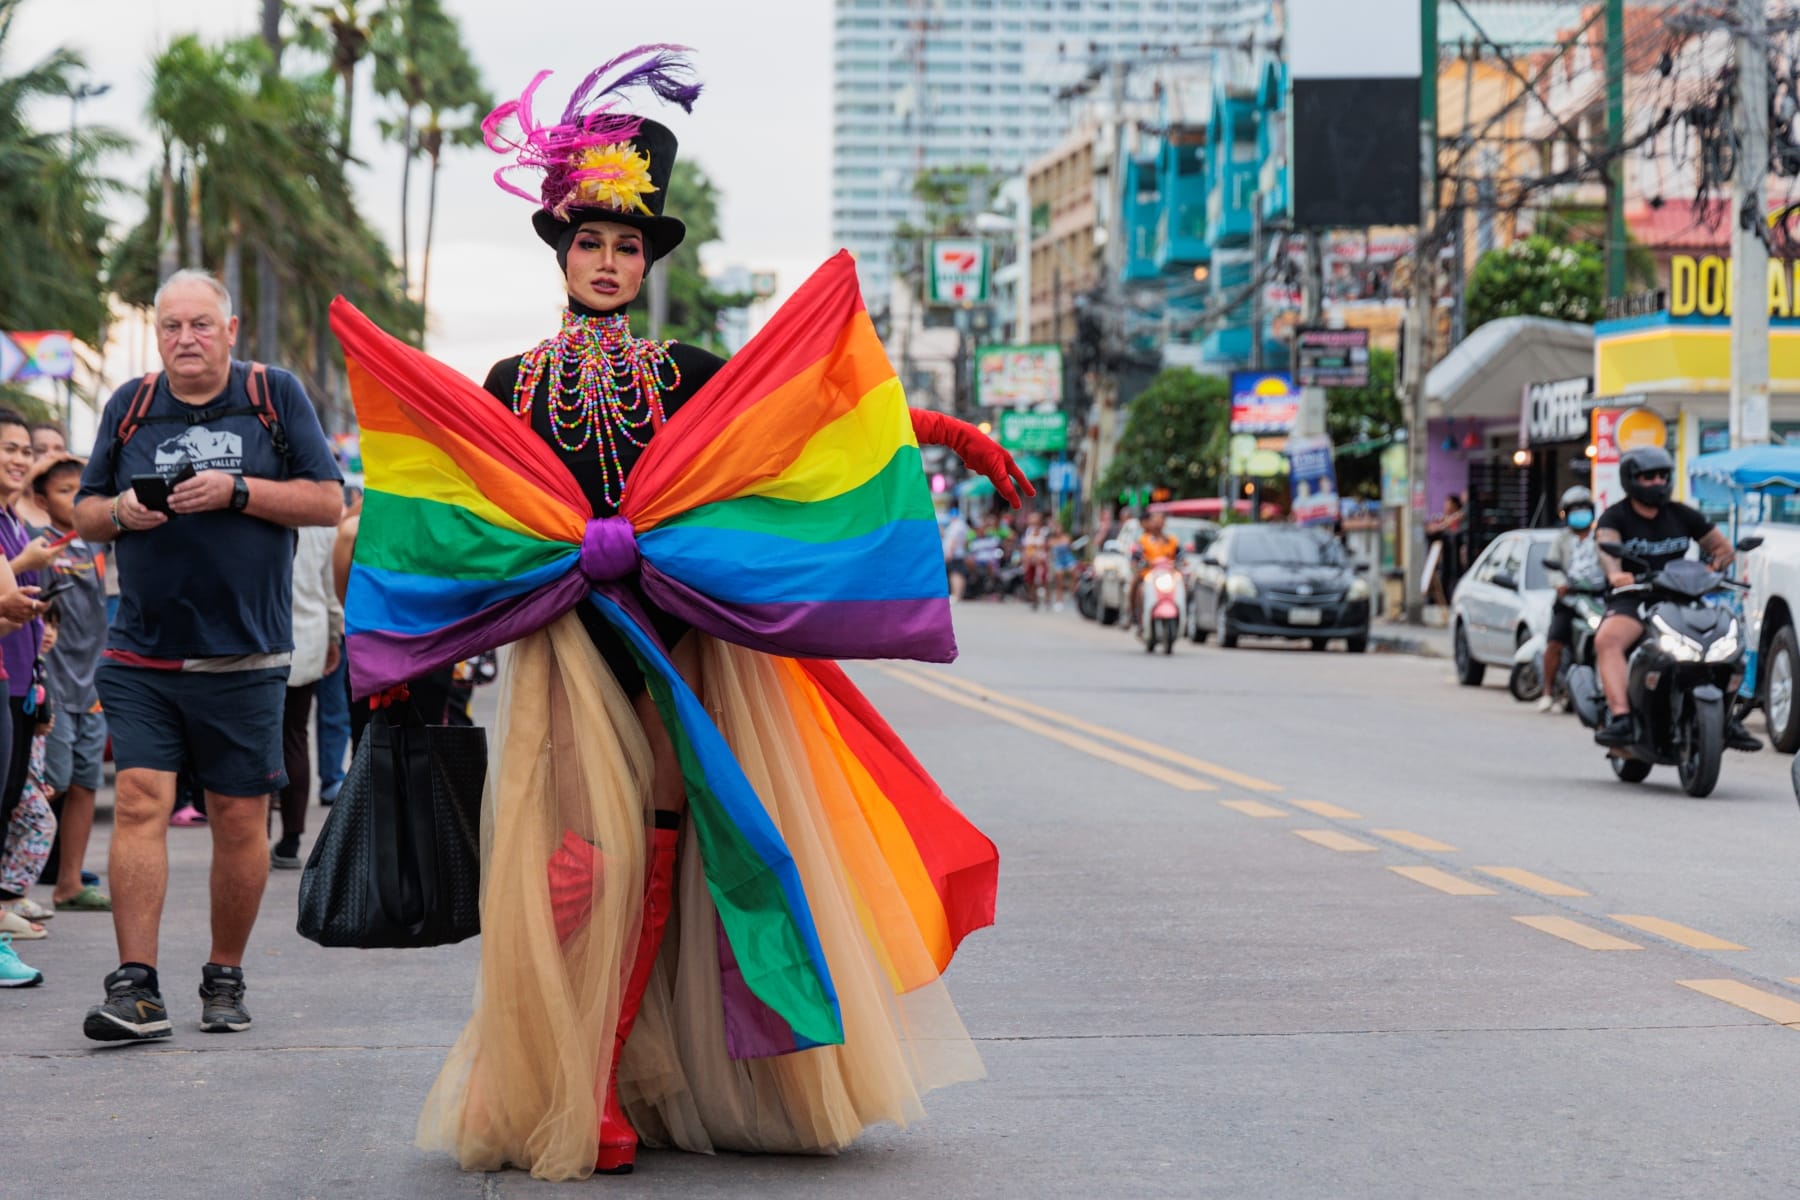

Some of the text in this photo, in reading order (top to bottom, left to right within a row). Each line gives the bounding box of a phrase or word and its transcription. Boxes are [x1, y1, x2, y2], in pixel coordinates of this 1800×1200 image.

[1671, 254, 1800, 317] DOA
[1530, 377, 1588, 438] COFFEE
[211, 459, 242, 468] VALLEY
